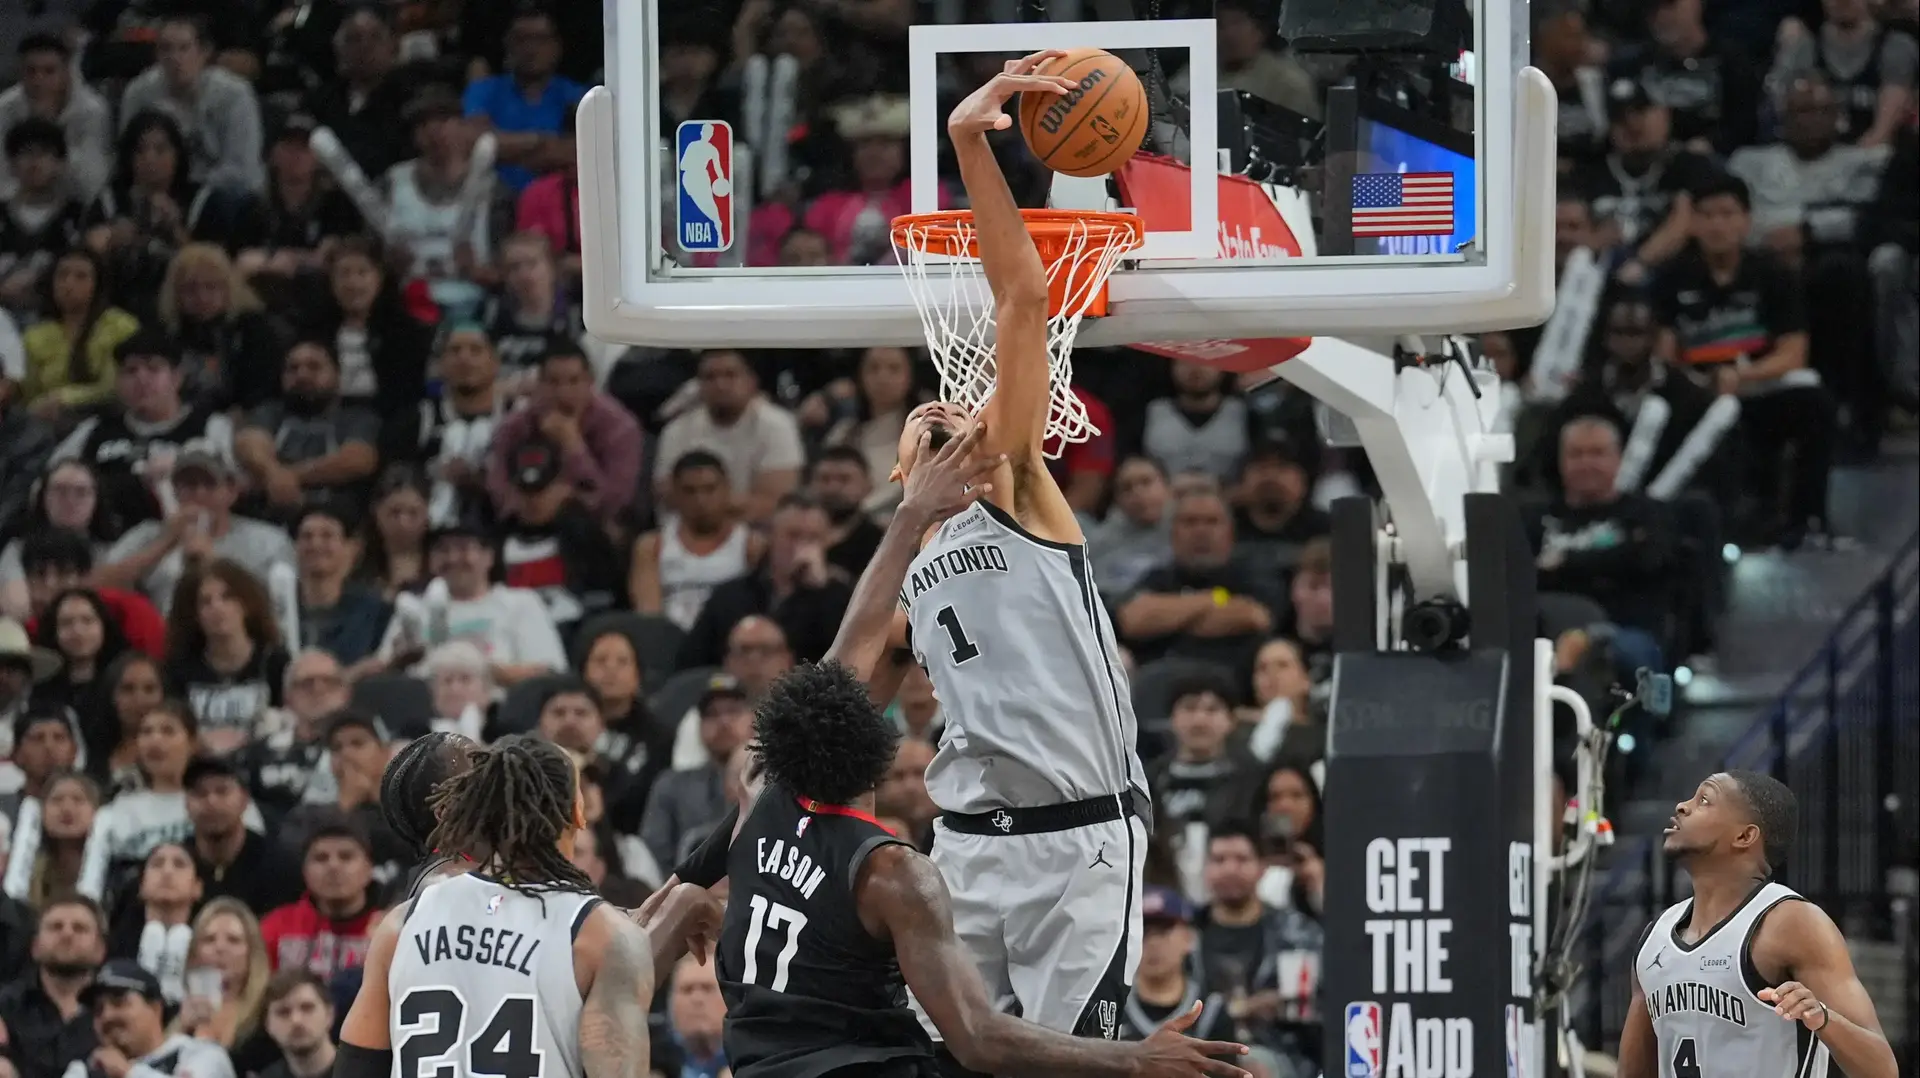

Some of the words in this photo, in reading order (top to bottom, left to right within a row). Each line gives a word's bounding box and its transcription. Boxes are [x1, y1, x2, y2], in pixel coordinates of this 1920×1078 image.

[1038, 68, 1107, 134] Wilson
[685, 221, 712, 243] NBA
[952, 513, 981, 533] LEDGER
[910, 544, 1009, 599] ANTONIO
[935, 604, 981, 665] 1
[757, 837, 826, 900] EASON
[1366, 837, 1451, 913] GET
[414, 924, 541, 977] VASSELL
[742, 893, 808, 993] 17
[1365, 918, 1453, 994] THE
[1703, 959, 1727, 967] LEDGER
[398, 986, 544, 1078] 24
[1664, 981, 1748, 1028] ANTONIO
[1386, 1003, 1474, 1078] App
[1673, 1037, 1702, 1078] 4
